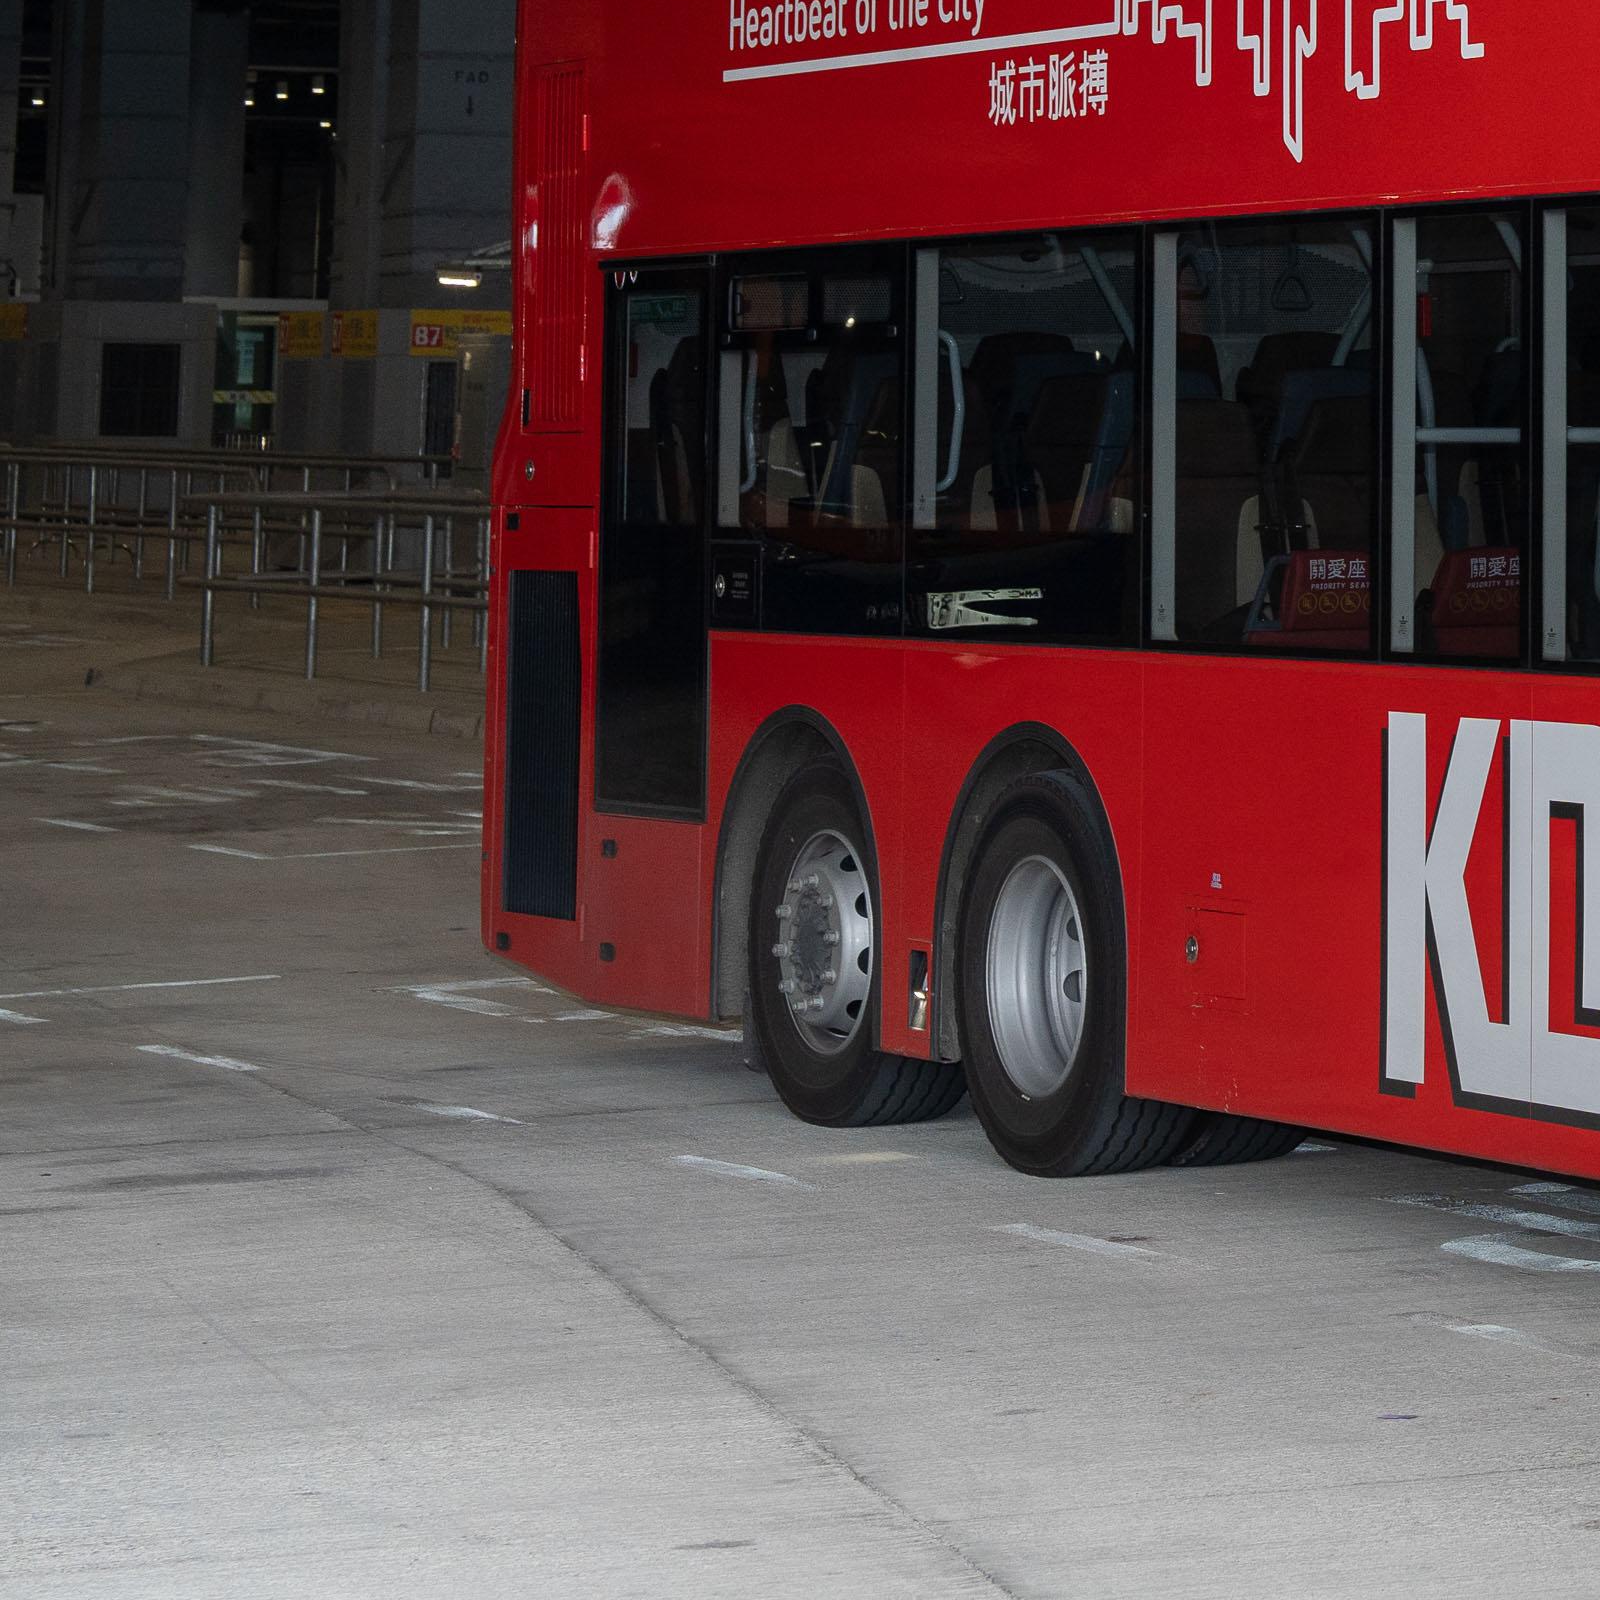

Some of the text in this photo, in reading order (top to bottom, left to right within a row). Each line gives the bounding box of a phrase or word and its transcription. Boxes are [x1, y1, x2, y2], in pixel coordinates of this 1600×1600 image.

[988, 49, 1110, 126] 城市脈搏
[1309, 558, 1368, 580] 關愛座
[1311, 581, 1345, 591] PRIORITY
